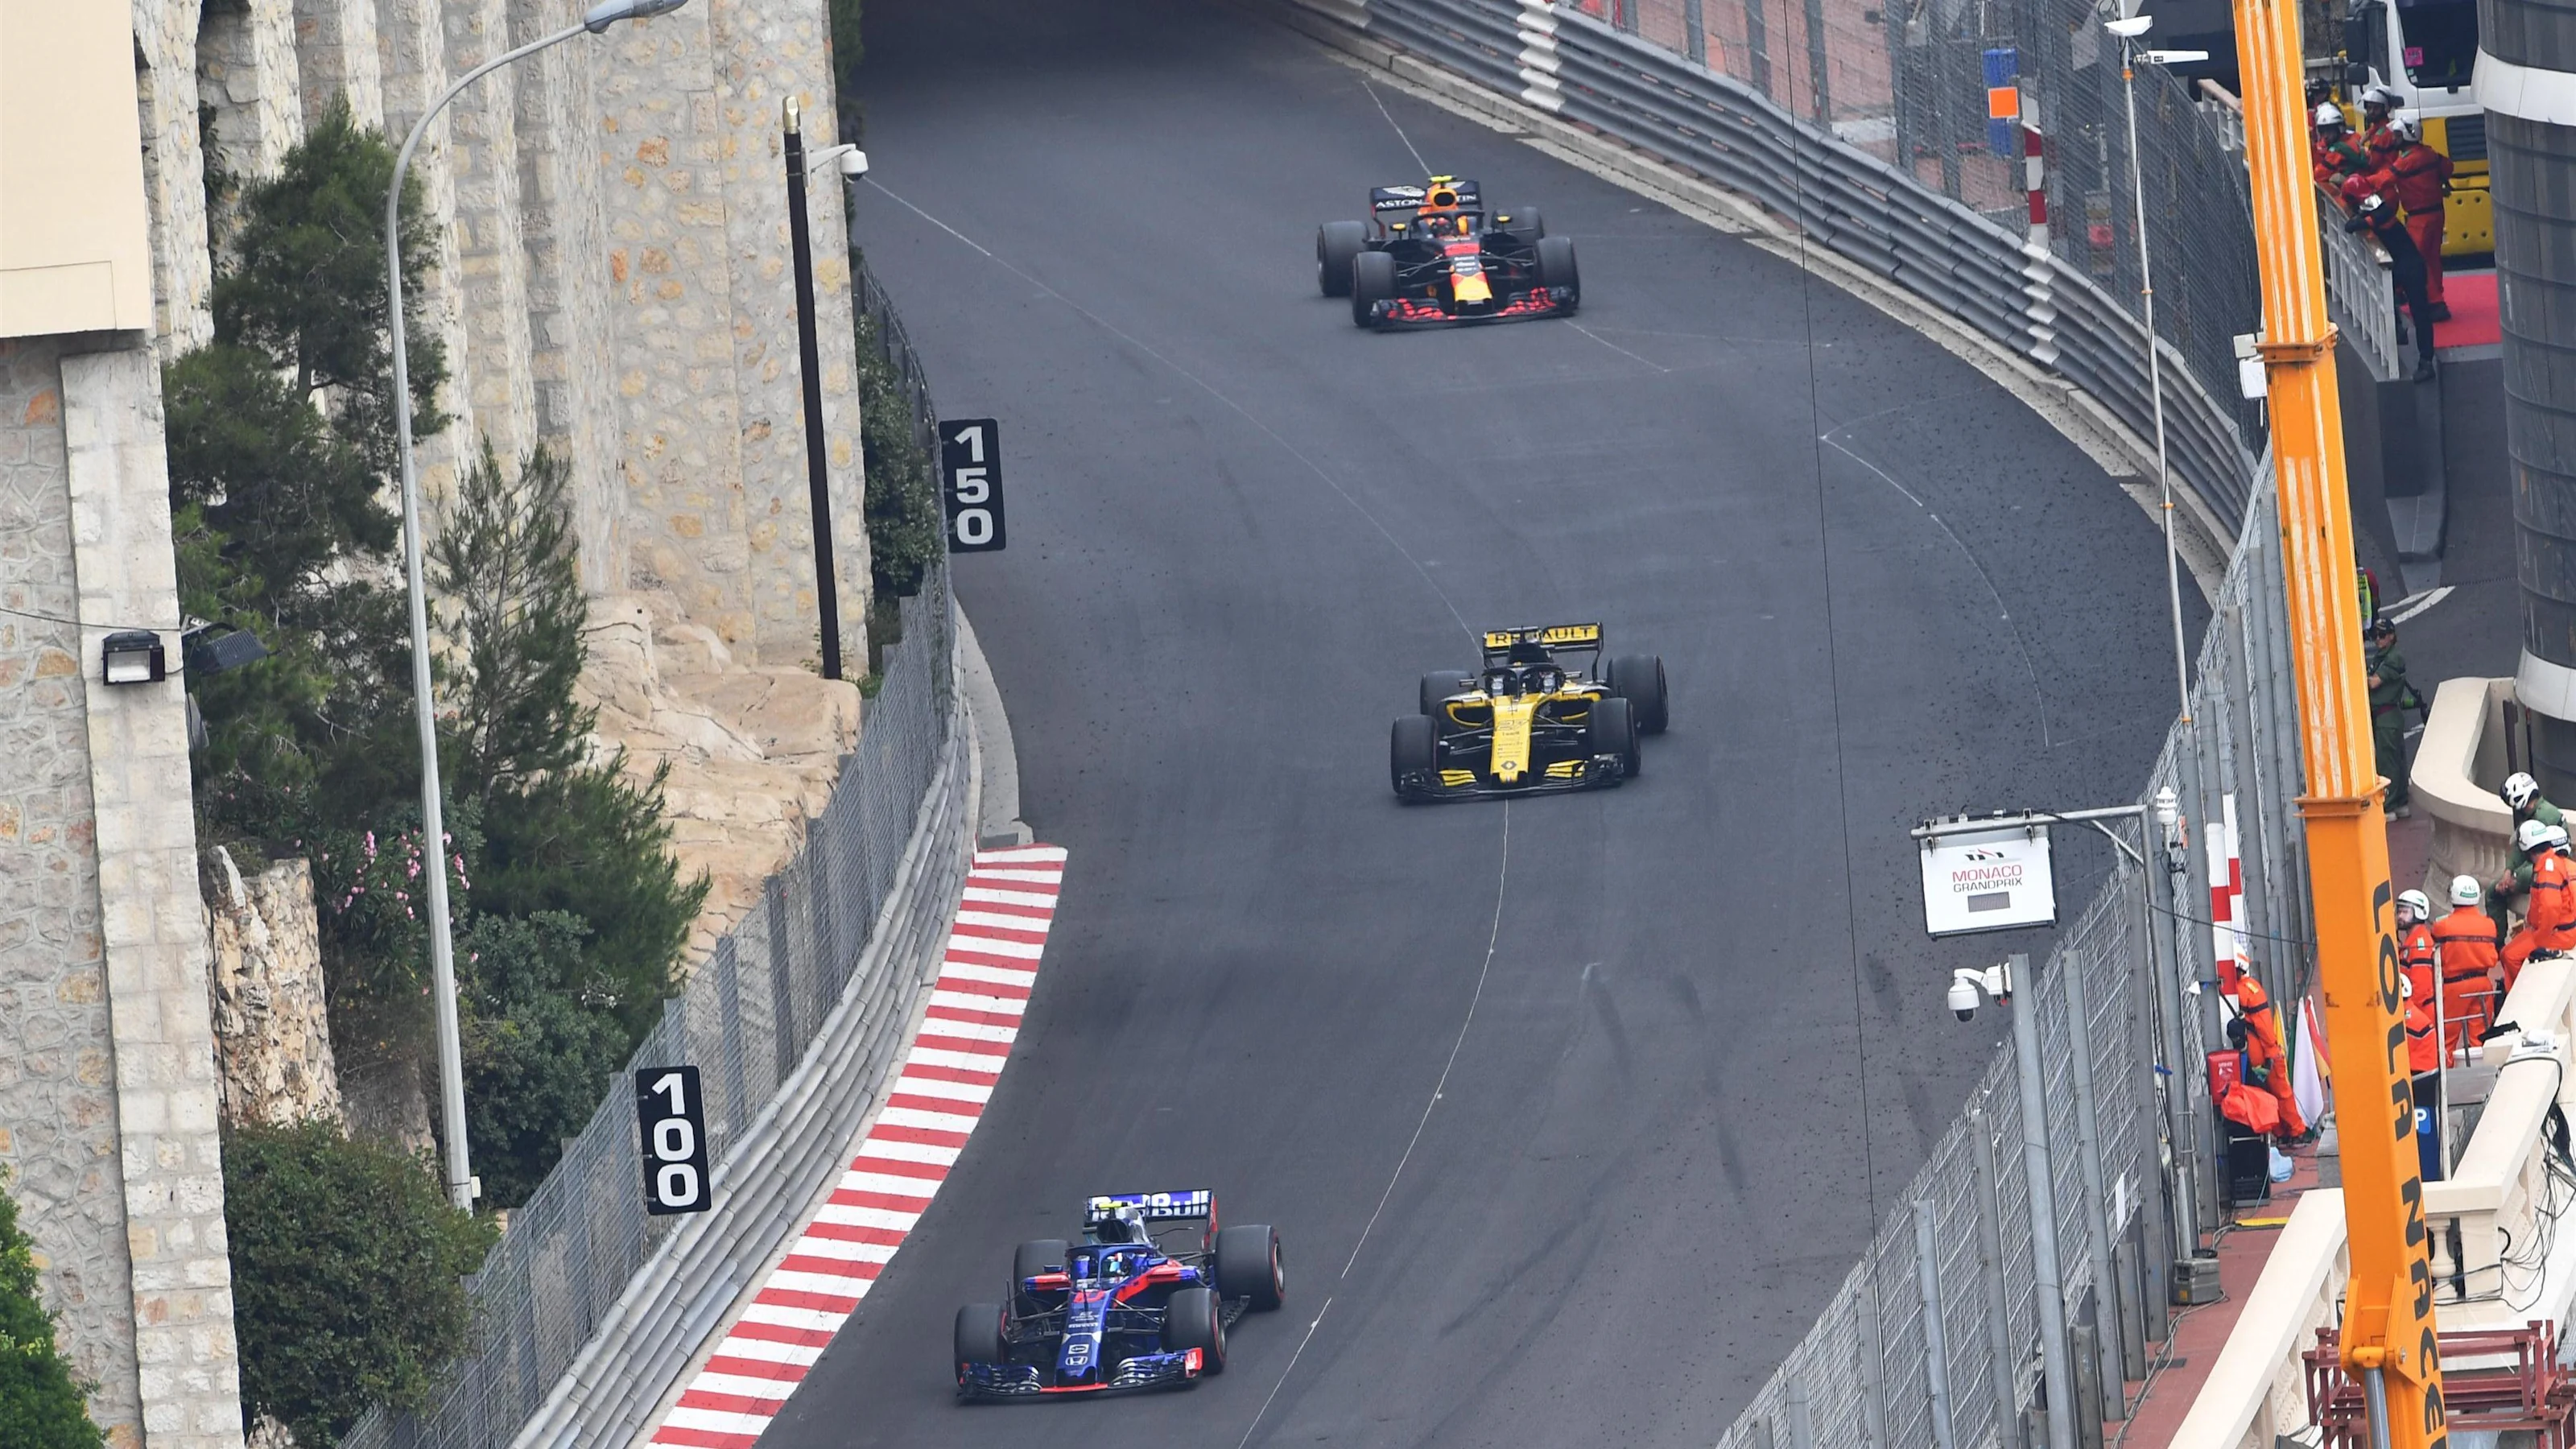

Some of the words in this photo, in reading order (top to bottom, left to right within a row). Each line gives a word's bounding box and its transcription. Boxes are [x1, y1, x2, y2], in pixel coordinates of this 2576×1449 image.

[1376, 198, 1422, 208] ASTON
[954, 426, 993, 545] 150
[1495, 626, 1592, 644] REAULT
[1952, 865, 2022, 882] MONACO
[2373, 880, 2413, 1141] LOLA
[2413, 1108, 2427, 1129] P
[652, 1073, 699, 1207] 100
[1151, 1190, 1209, 1216] Bull
[2401, 1175, 2448, 1449] NACE
